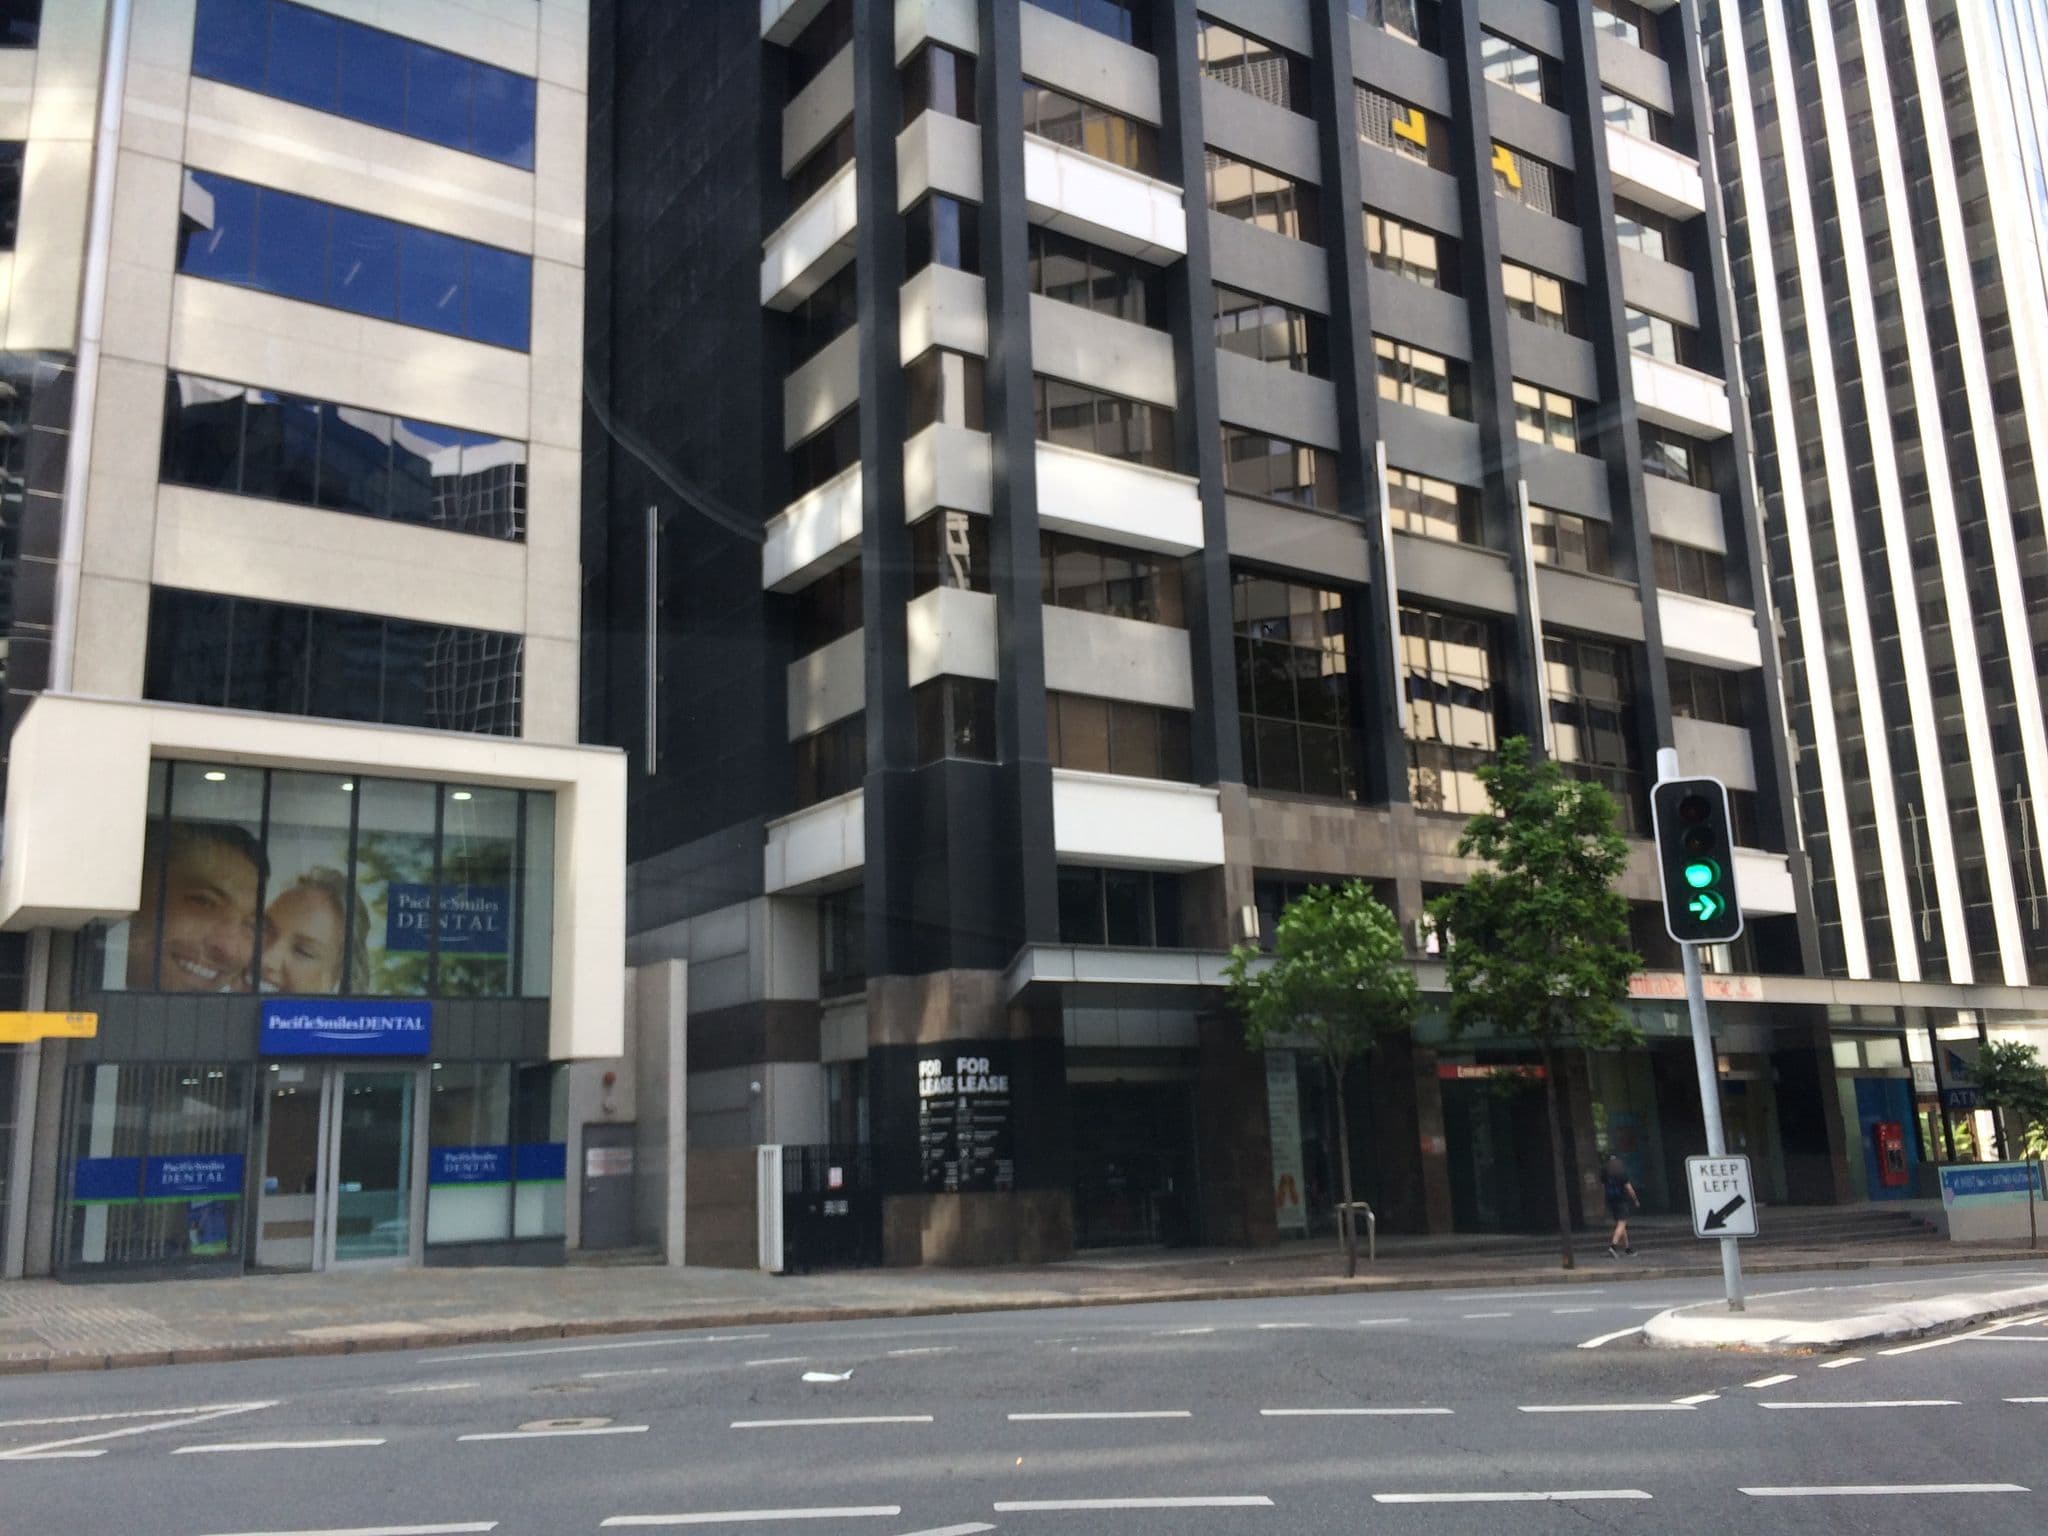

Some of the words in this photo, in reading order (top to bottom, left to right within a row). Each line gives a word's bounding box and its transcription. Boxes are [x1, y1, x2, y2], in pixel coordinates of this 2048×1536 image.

[397, 911, 499, 931] DENTAL
[919, 1059, 942, 1078] FOR
[957, 1057, 989, 1074] FOR
[919, 1076, 954, 1097] LEASE
[957, 1075, 1008, 1093] LEASE
[162, 1172, 224, 1185] DENTAL
[1699, 1163, 1739, 1177] KEEP
[1703, 1179, 1739, 1193] LEFT
